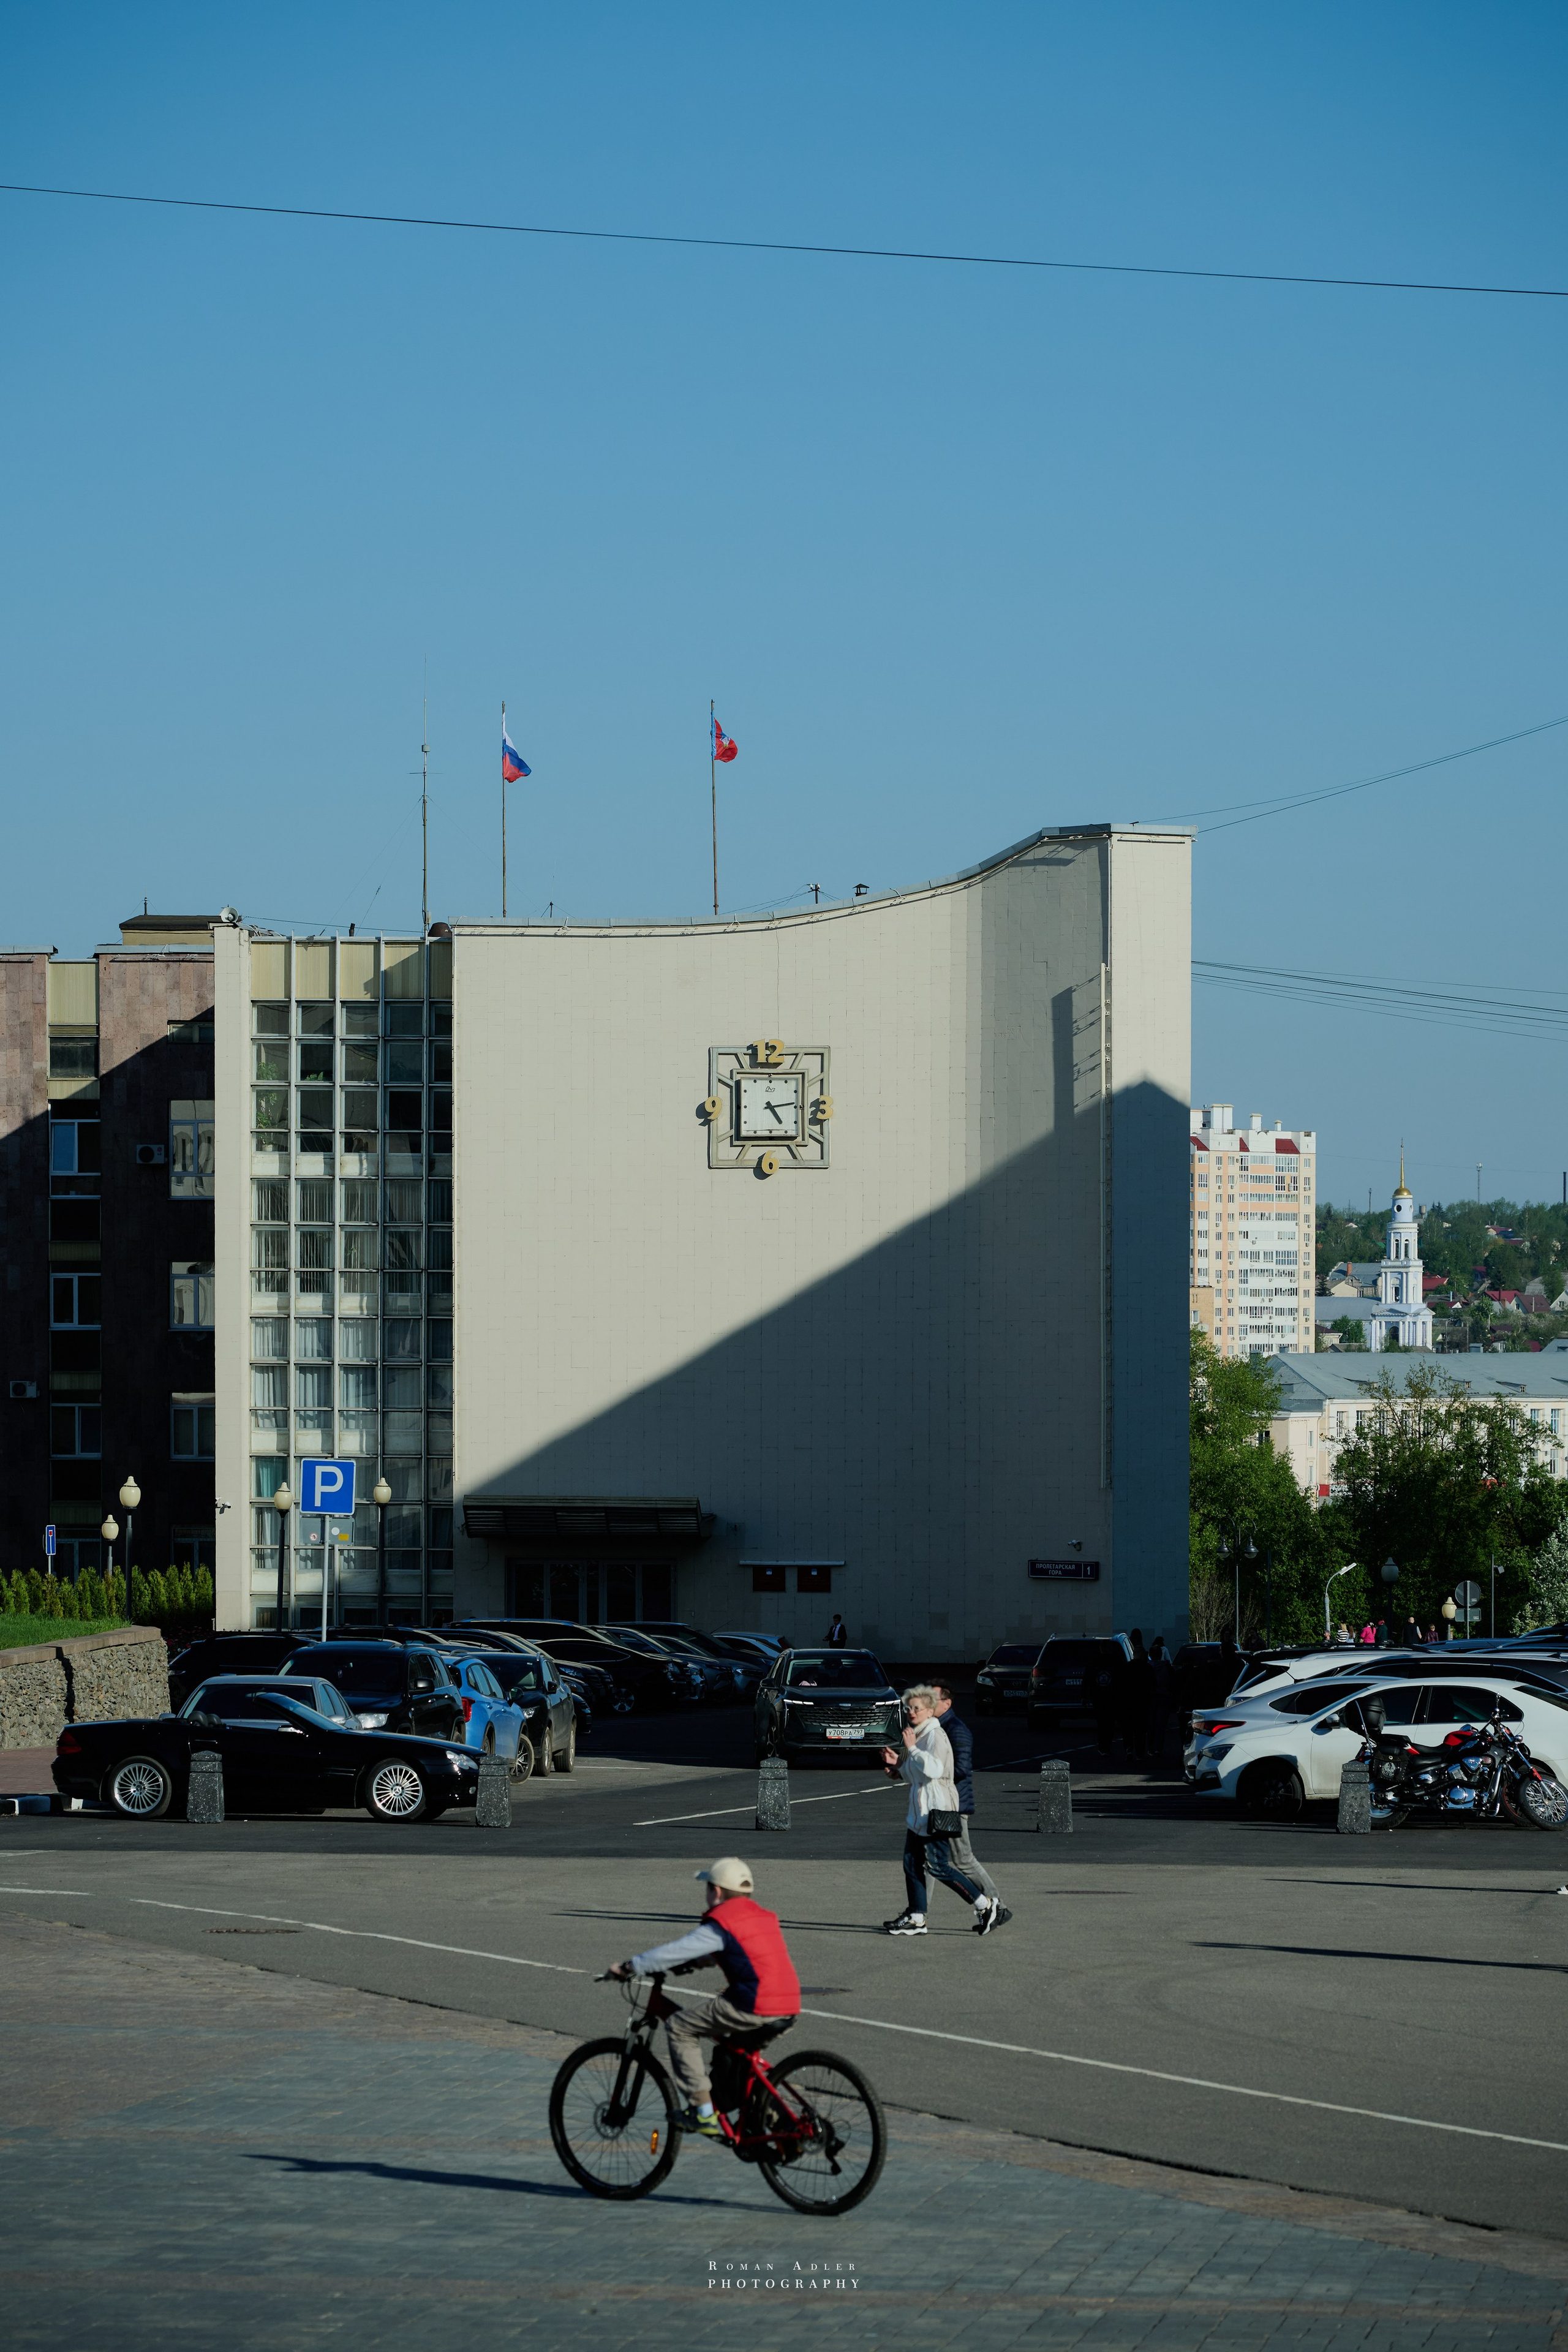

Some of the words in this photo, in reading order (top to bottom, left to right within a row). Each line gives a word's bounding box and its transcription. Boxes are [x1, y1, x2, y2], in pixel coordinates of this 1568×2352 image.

[753, 1038, 785, 1063] 12
[704, 1096, 723, 1120] 9
[816, 1095, 834, 1120] 3
[761, 1150, 780, 1174] 6
[314, 1465, 344, 1507] P
[1087, 1566, 1090, 1575] 1
